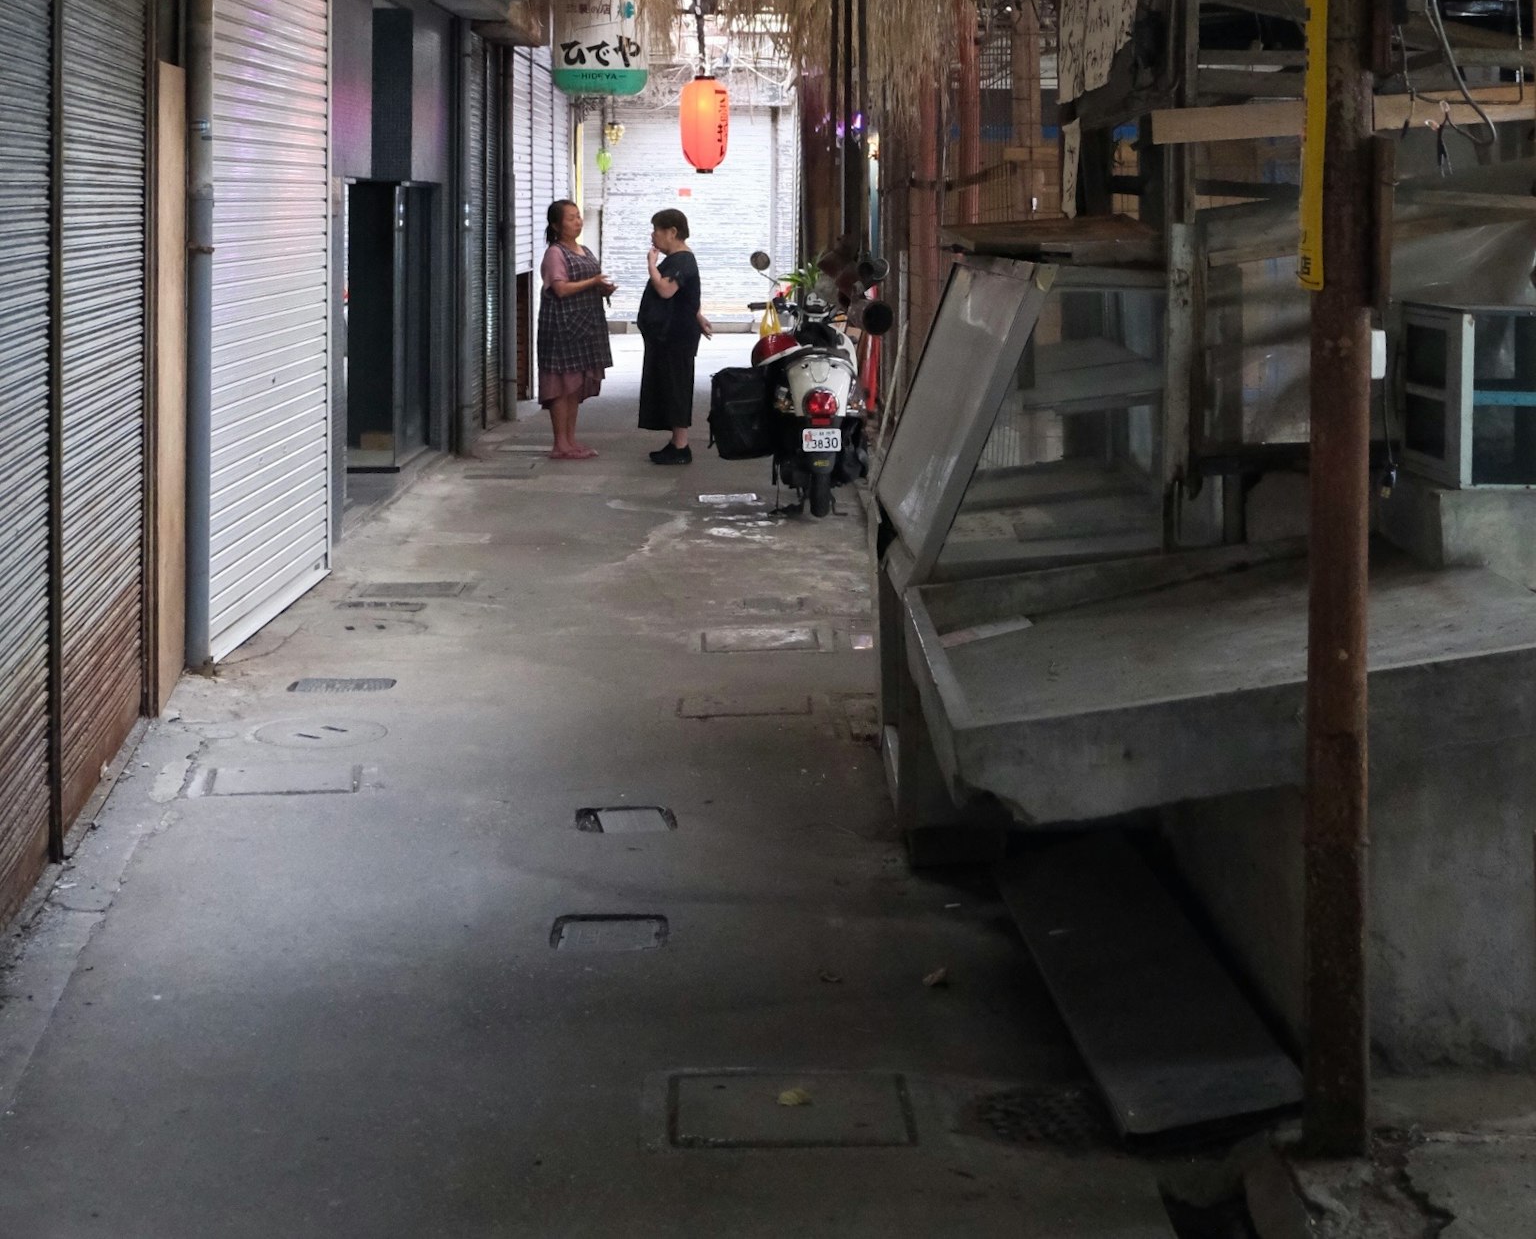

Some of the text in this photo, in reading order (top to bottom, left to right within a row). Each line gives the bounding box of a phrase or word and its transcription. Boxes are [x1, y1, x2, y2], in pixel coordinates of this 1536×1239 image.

[560, 34, 640, 68] ひでや
[812, 437, 839, 449] 3830
